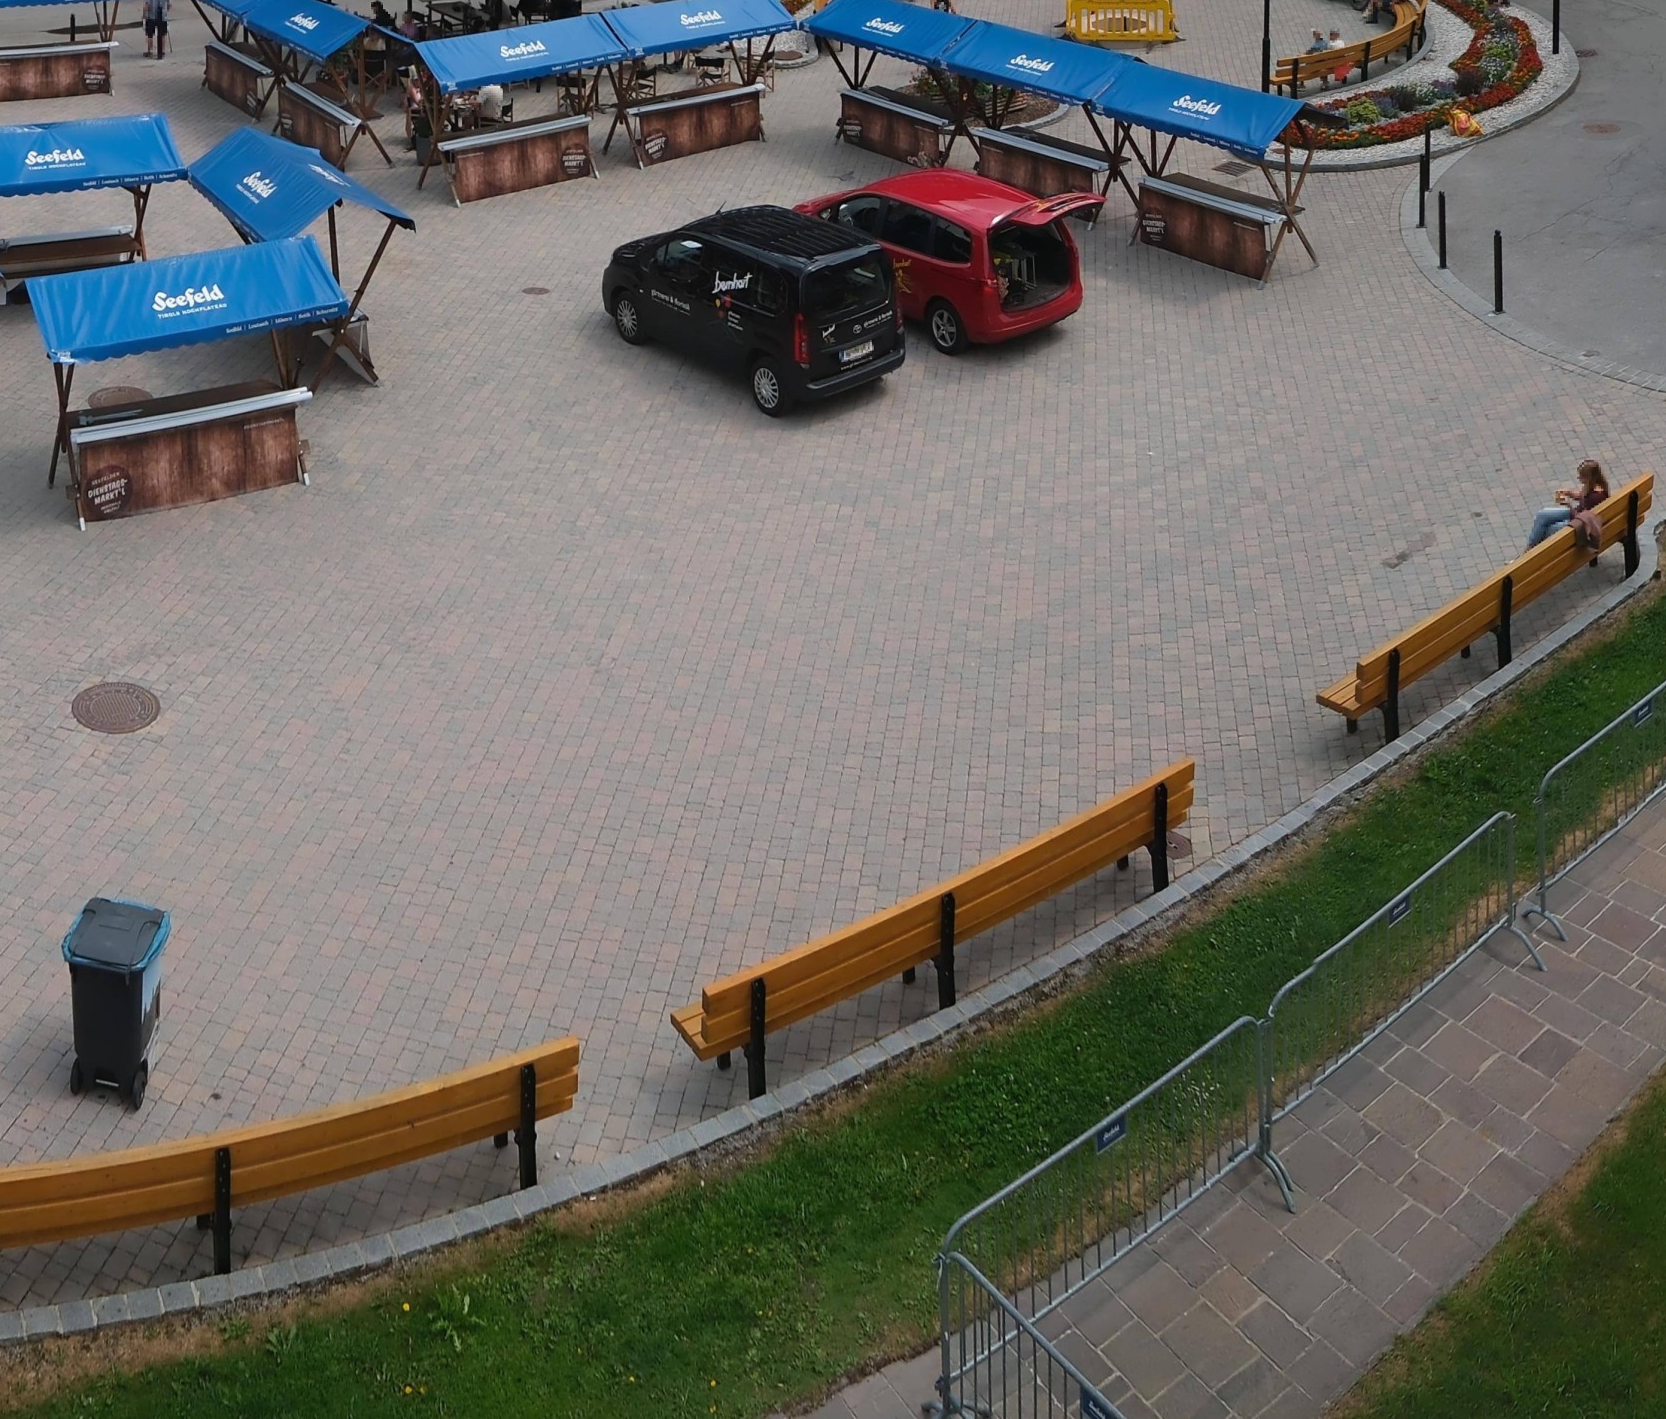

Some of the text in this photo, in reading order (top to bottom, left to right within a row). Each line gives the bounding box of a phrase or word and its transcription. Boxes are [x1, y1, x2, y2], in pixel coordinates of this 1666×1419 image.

[680, 9, 722, 26] Seefeld
[866, 17, 902, 35] Seefeld
[500, 40, 546, 58] Seefeld
[1010, 53, 1055, 73] Seefeld
[1173, 94, 1222, 116] Seefeld
[25, 149, 85, 166] Seefeld
[243, 171, 277, 198] Seefeld
[152, 283, 225, 311] Seefeld
[157, 303, 227, 319] TIROLS HOCHPLATEAU
